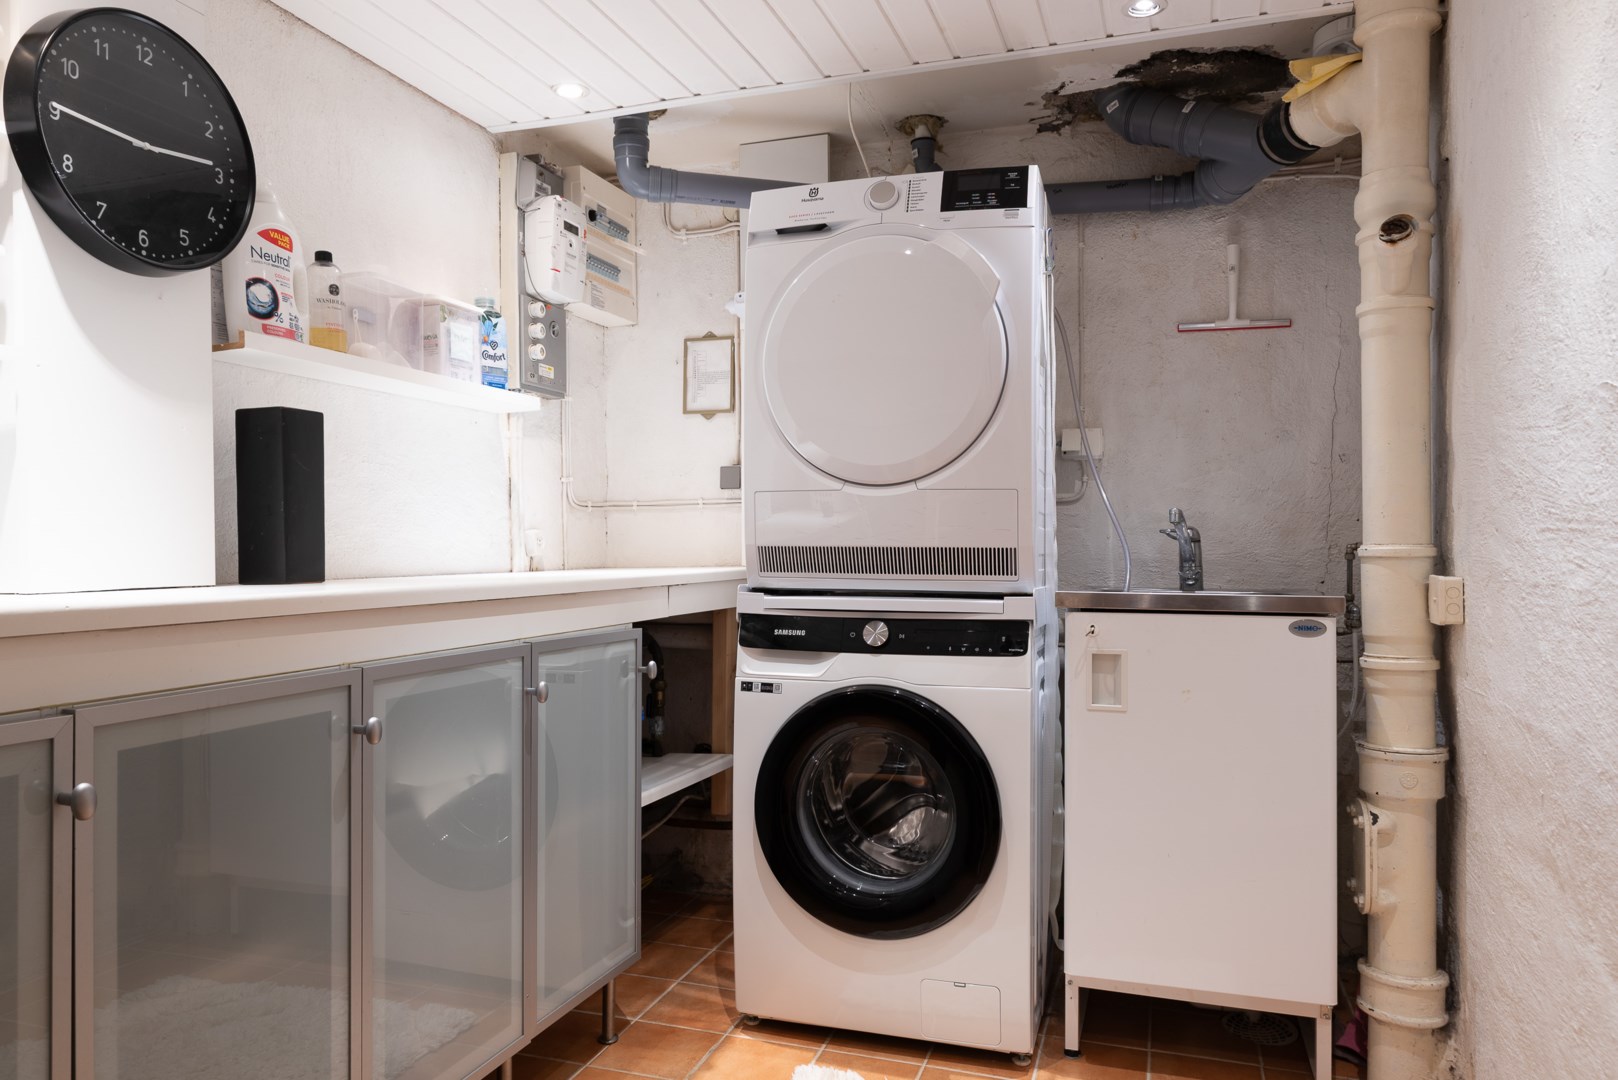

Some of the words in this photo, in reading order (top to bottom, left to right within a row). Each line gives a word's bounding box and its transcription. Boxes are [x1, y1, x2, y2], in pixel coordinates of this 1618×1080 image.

[94, 38, 109, 60] 11
[136, 44, 153, 67] 12
[60, 57, 80, 80] 10
[182, 81, 188, 97] 1
[48, 101, 60, 120] 9
[205, 121, 214, 139] 2
[62, 154, 74, 173] 8
[215, 168, 224, 184] 3
[96, 201, 107, 219] 7
[207, 206, 217, 223] 4
[138, 229, 149, 247] 6
[179, 228, 190, 246] 5
[269, 230, 290, 243] VALUE
[278, 240, 290, 249] PACK
[250, 245, 290, 267] Neutral
[481, 350, 506, 362] Comfort
